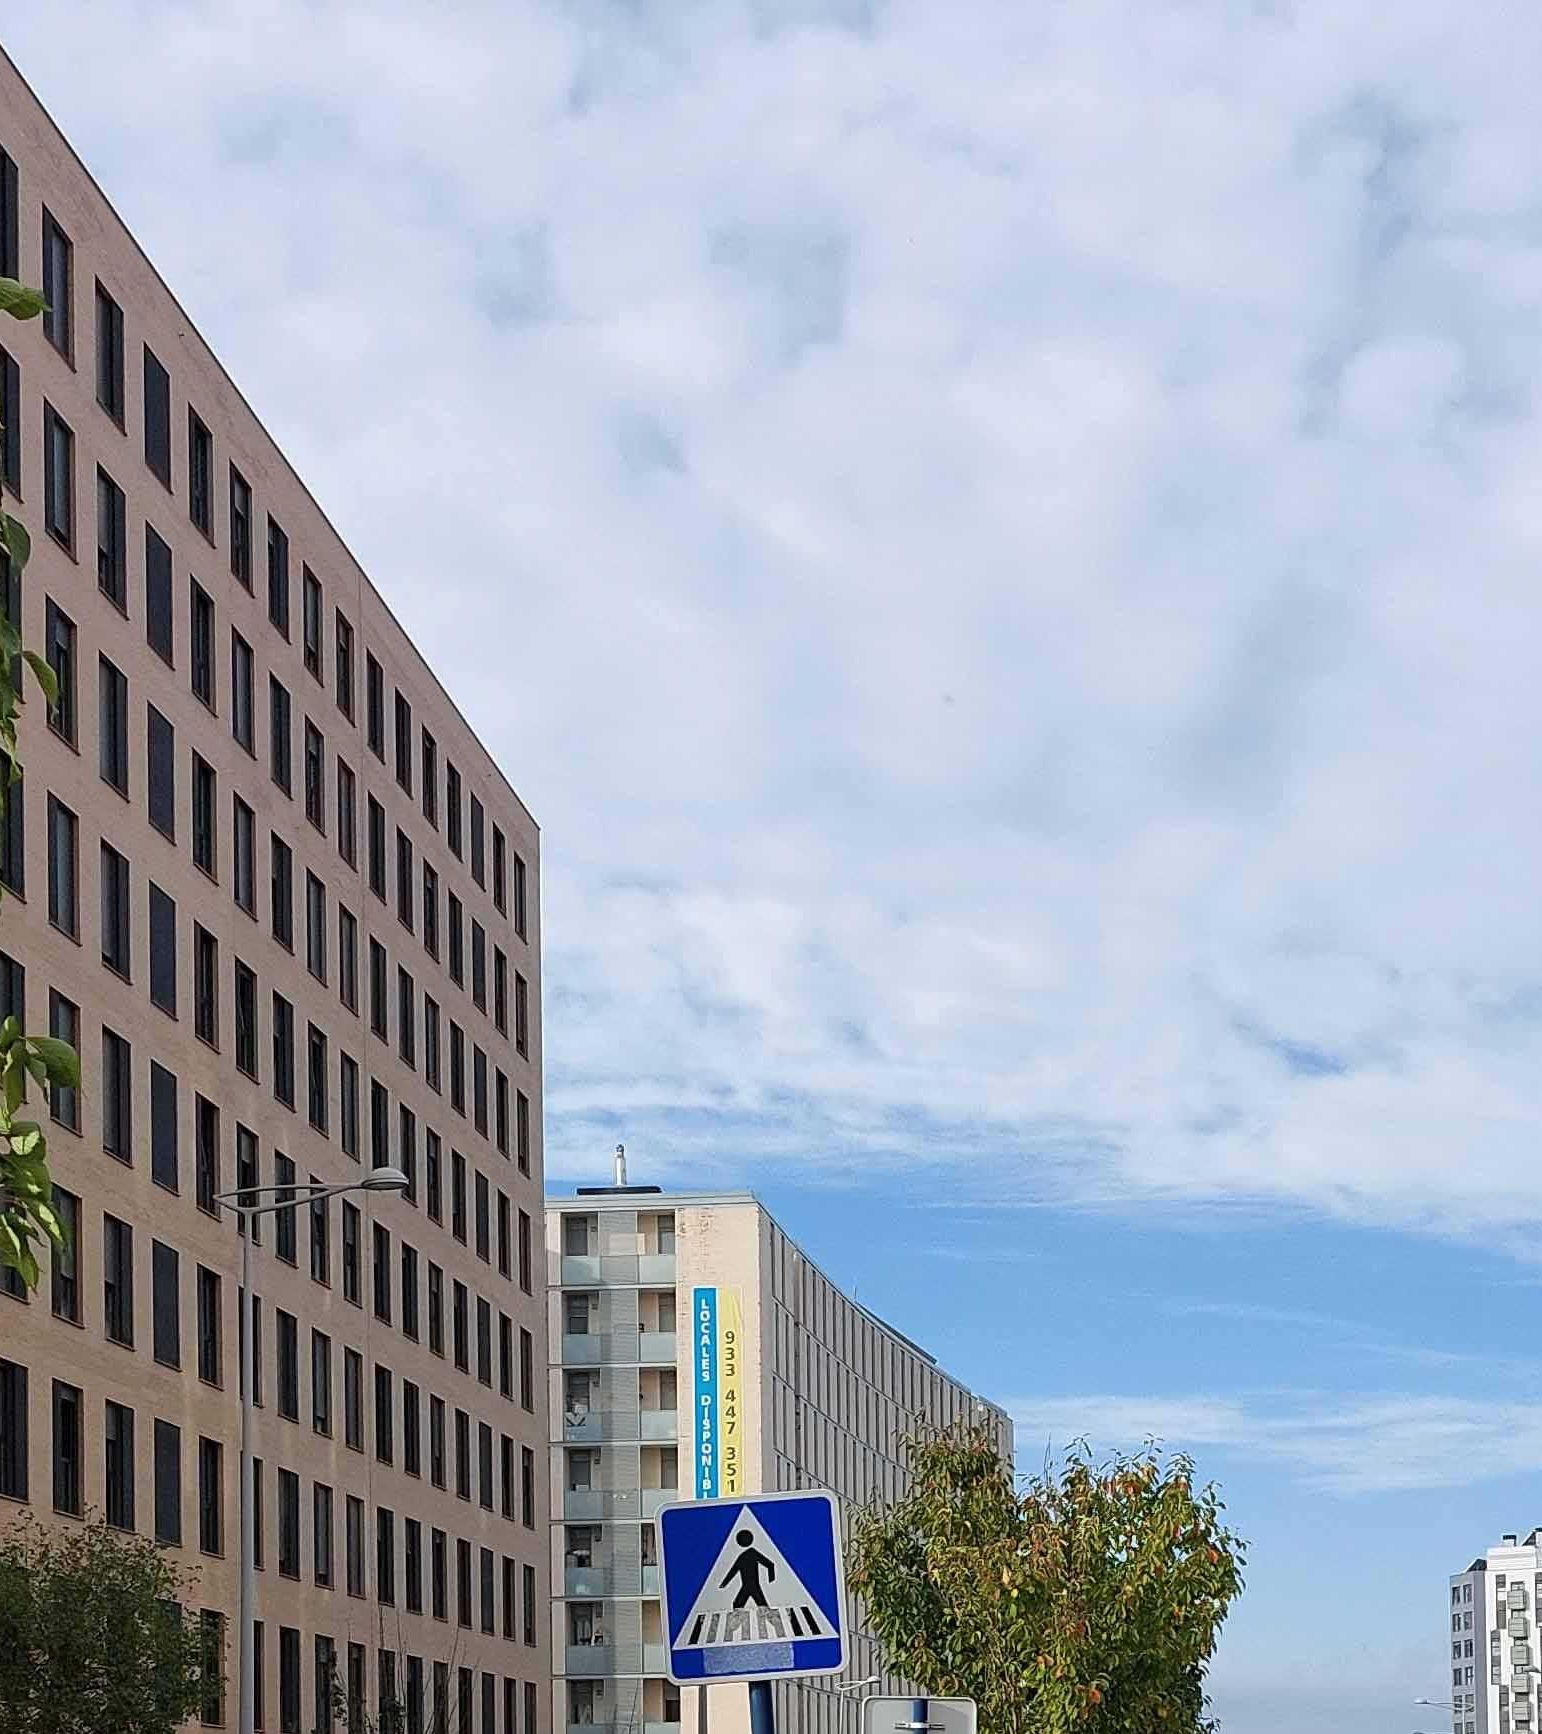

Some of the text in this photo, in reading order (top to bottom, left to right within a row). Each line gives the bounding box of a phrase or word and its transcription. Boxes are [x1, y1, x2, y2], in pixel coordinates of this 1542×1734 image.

[700, 1299, 712, 1382] LOCALES
[725, 1330, 737, 1493] 933 447 351
